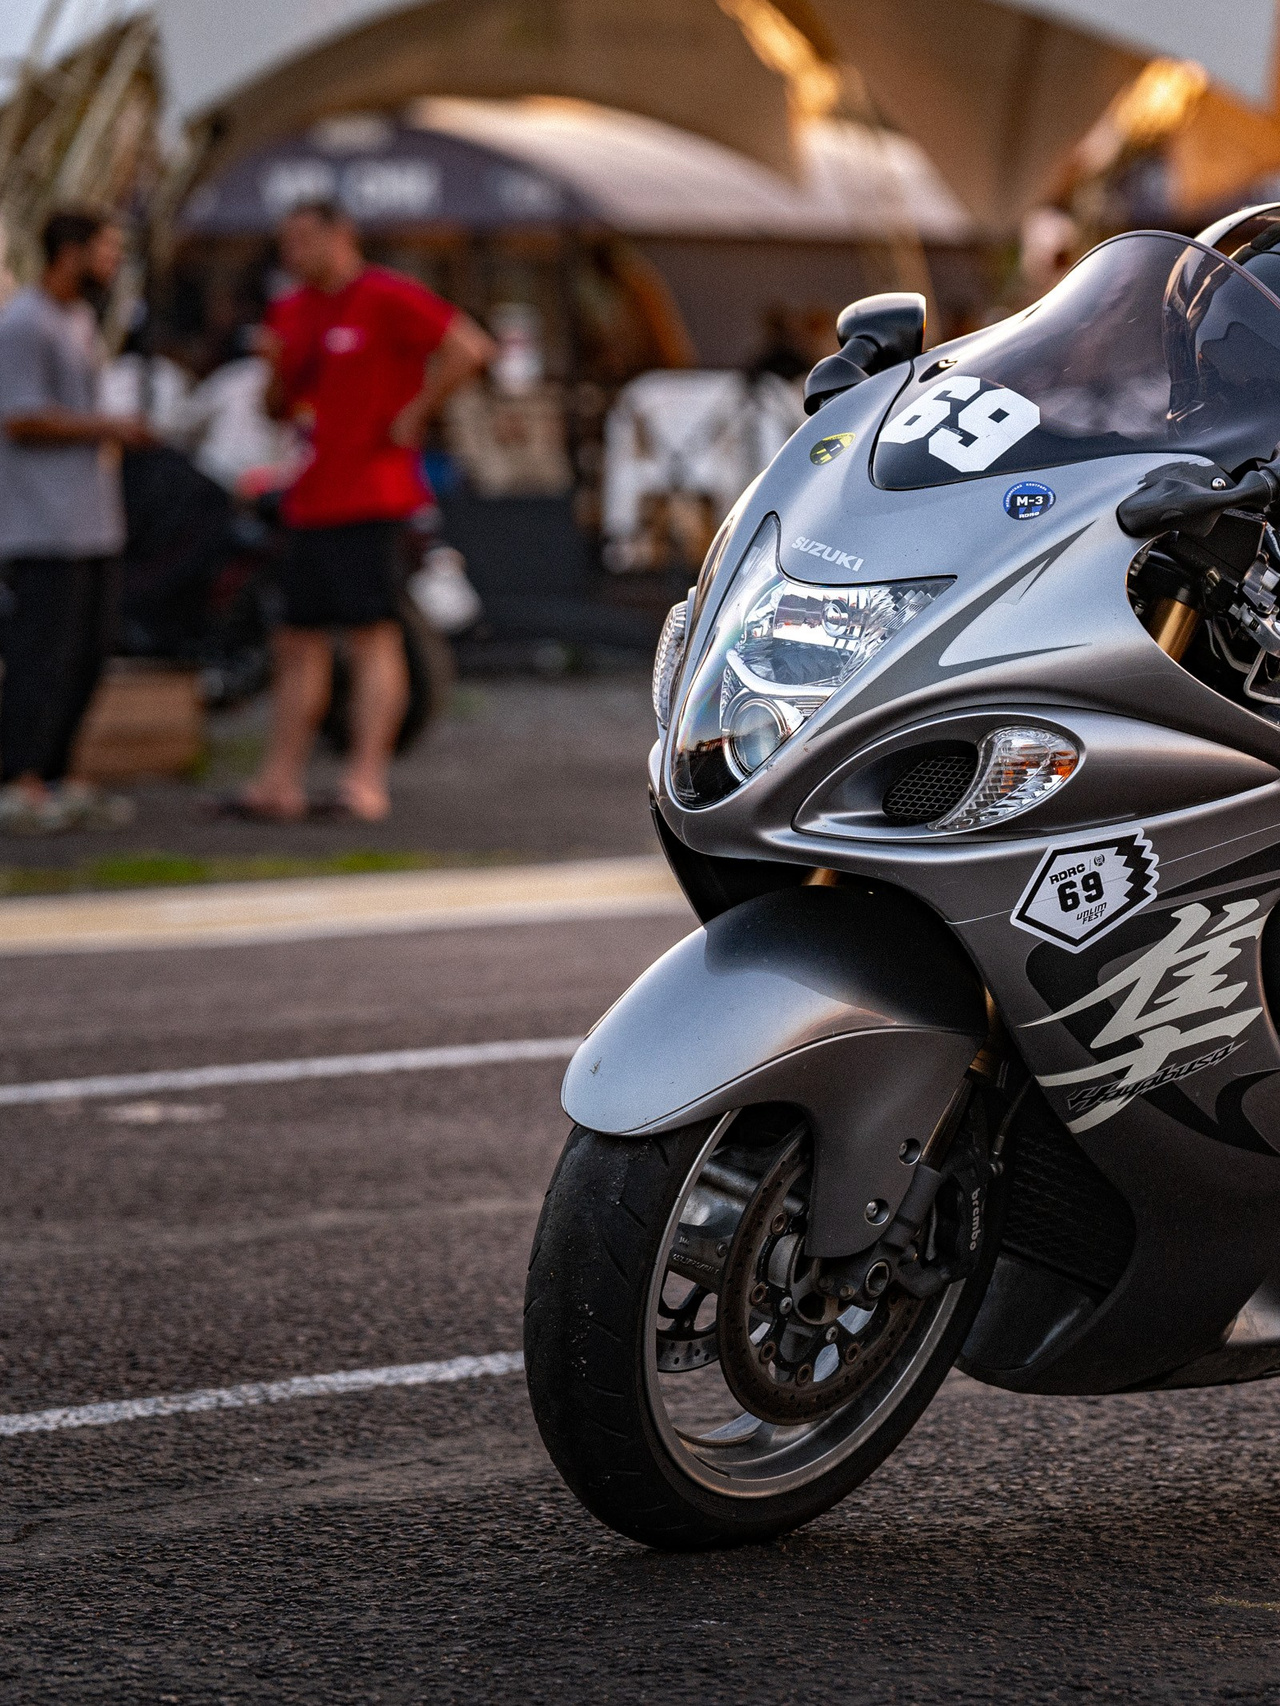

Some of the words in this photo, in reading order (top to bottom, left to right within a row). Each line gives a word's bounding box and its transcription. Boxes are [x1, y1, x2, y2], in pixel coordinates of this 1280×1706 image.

[878, 376, 1041, 473] 69
[1016, 496, 1044, 506] M-3
[791, 536, 864, 572] SUZUKI
[1049, 863, 1086, 885] RDRC
[1057, 871, 1104, 913] 69
[1076, 902, 1107, 921] UNLIM
[1082, 910, 1105, 925] FEST
[969, 1187, 982, 1251] brembo
